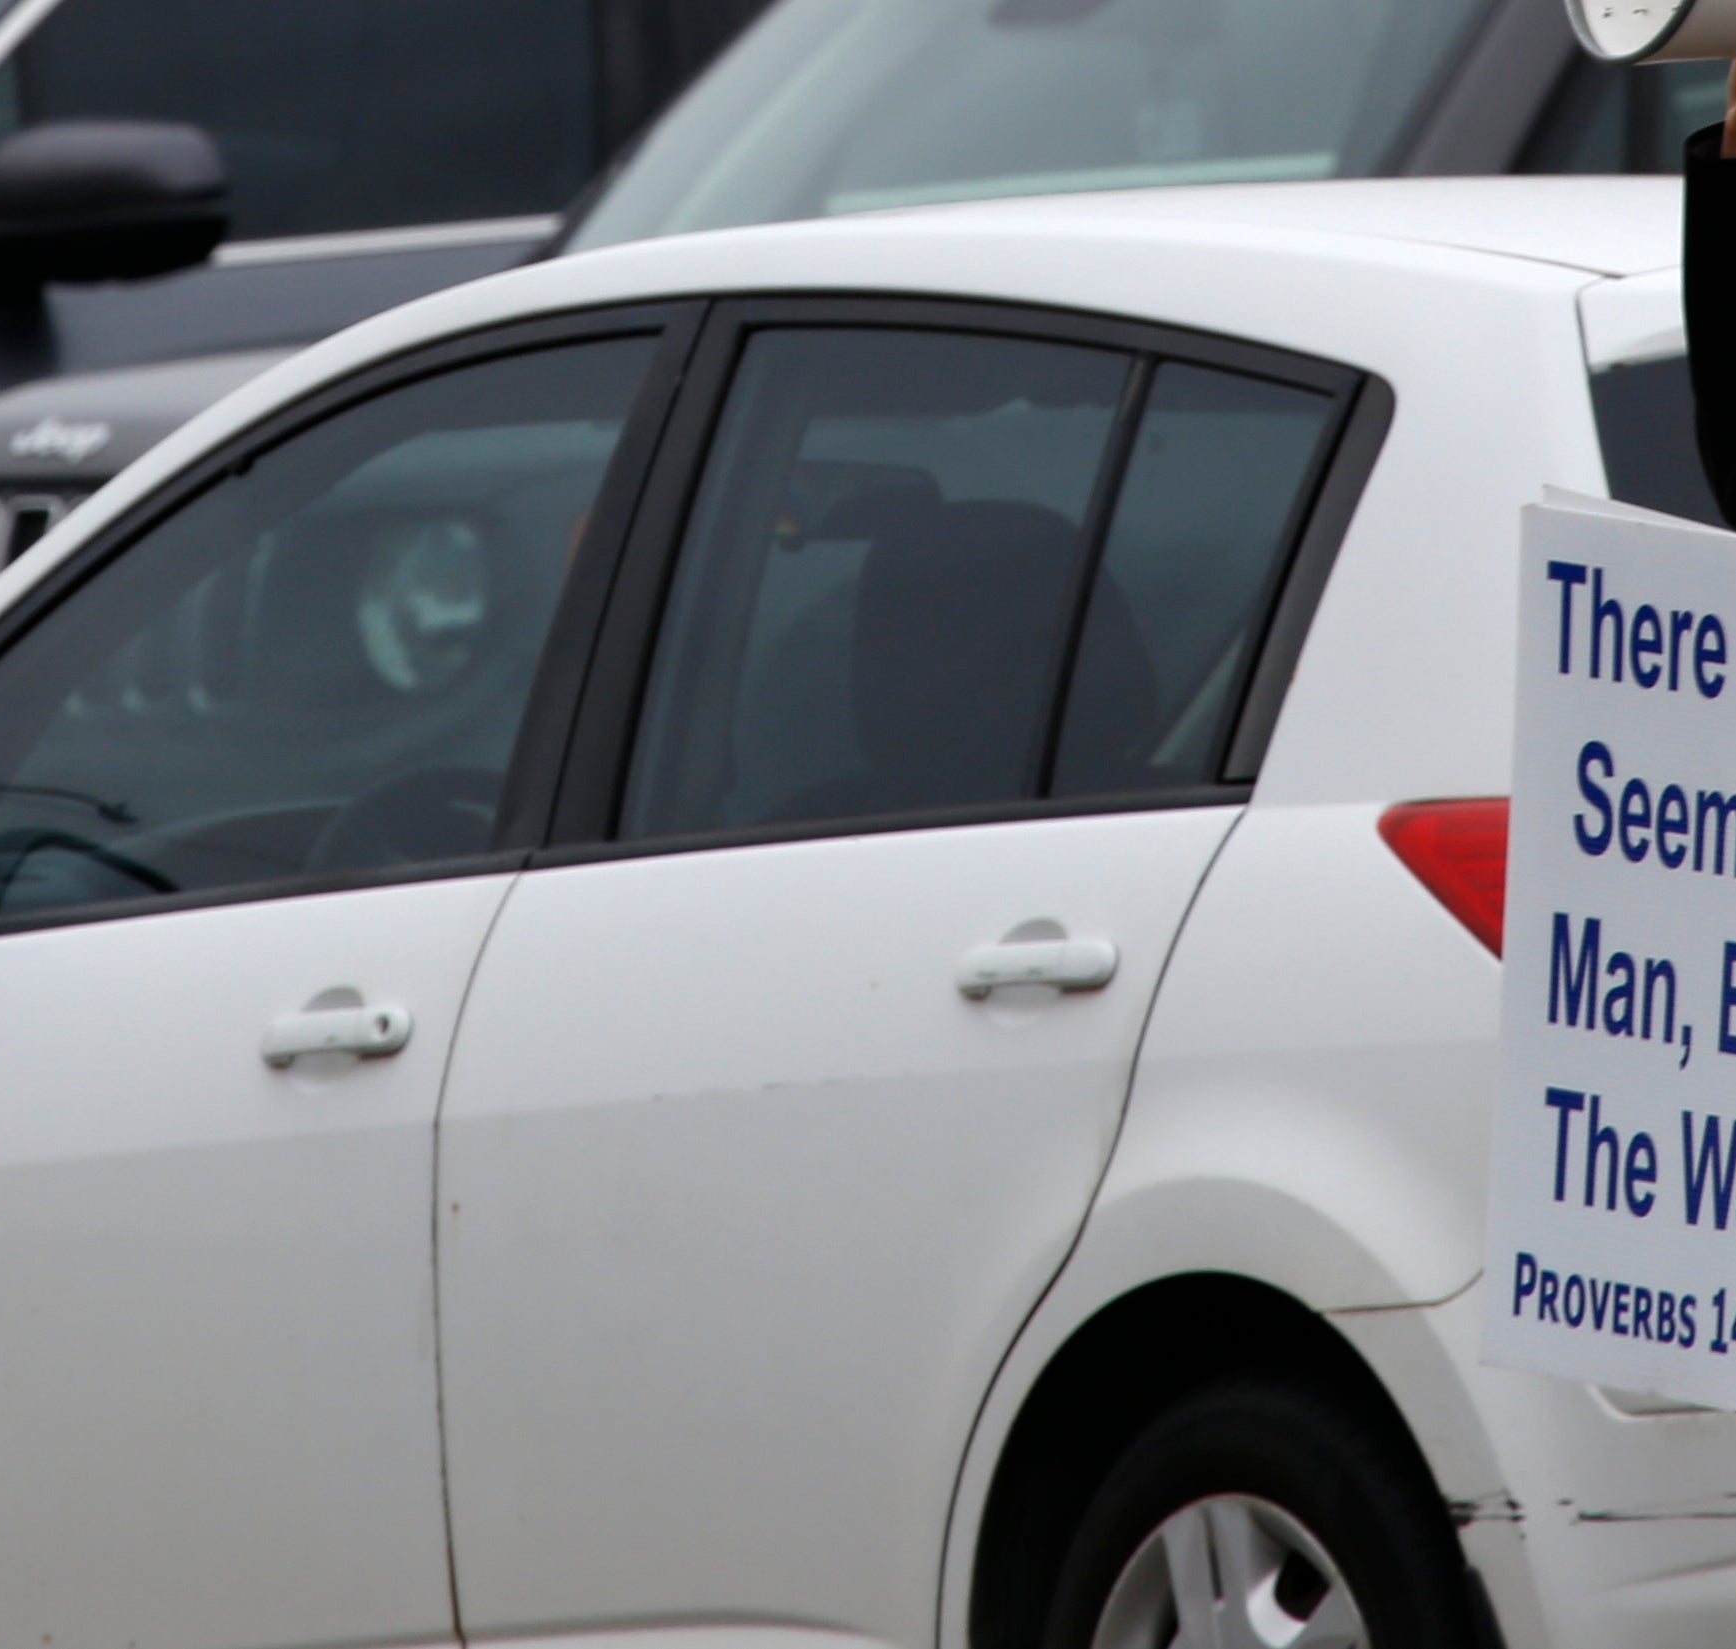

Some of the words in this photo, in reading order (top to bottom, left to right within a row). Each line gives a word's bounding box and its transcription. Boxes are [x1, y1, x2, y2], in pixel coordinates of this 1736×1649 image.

[1547, 560, 1727, 698] There
[1547, 911, 1692, 1066] Man,
[1544, 1086, 1658, 1217] The
